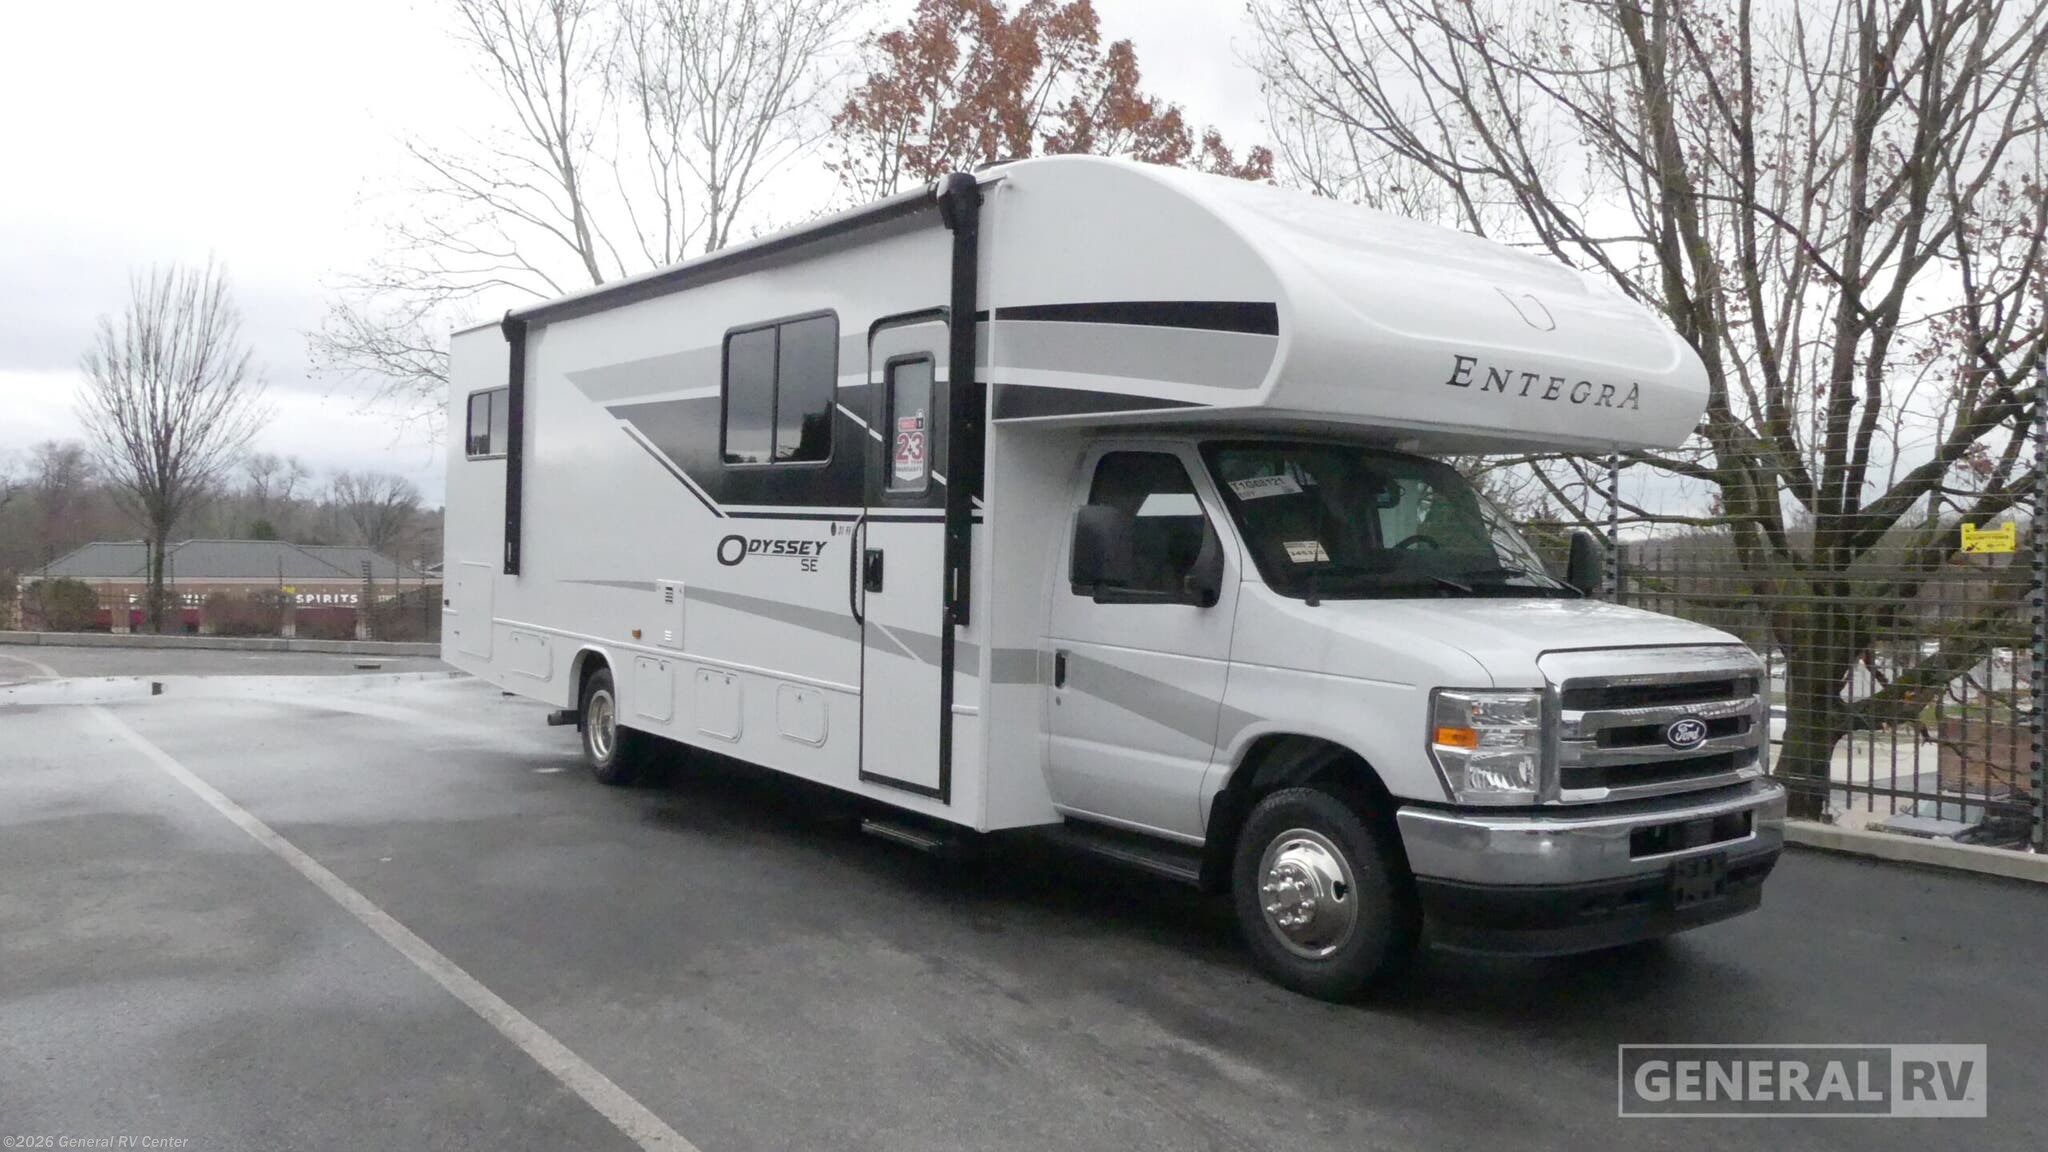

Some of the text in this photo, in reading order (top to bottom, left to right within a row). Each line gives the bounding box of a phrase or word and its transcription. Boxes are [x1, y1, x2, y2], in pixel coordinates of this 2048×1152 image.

[1445, 354, 1640, 410] ENTEGRA
[717, 534, 827, 566] ODYSSEY
[801, 558, 818, 572] SE
[296, 594, 358, 604] SPIRITS
[1675, 723, 1700, 741] Ford
